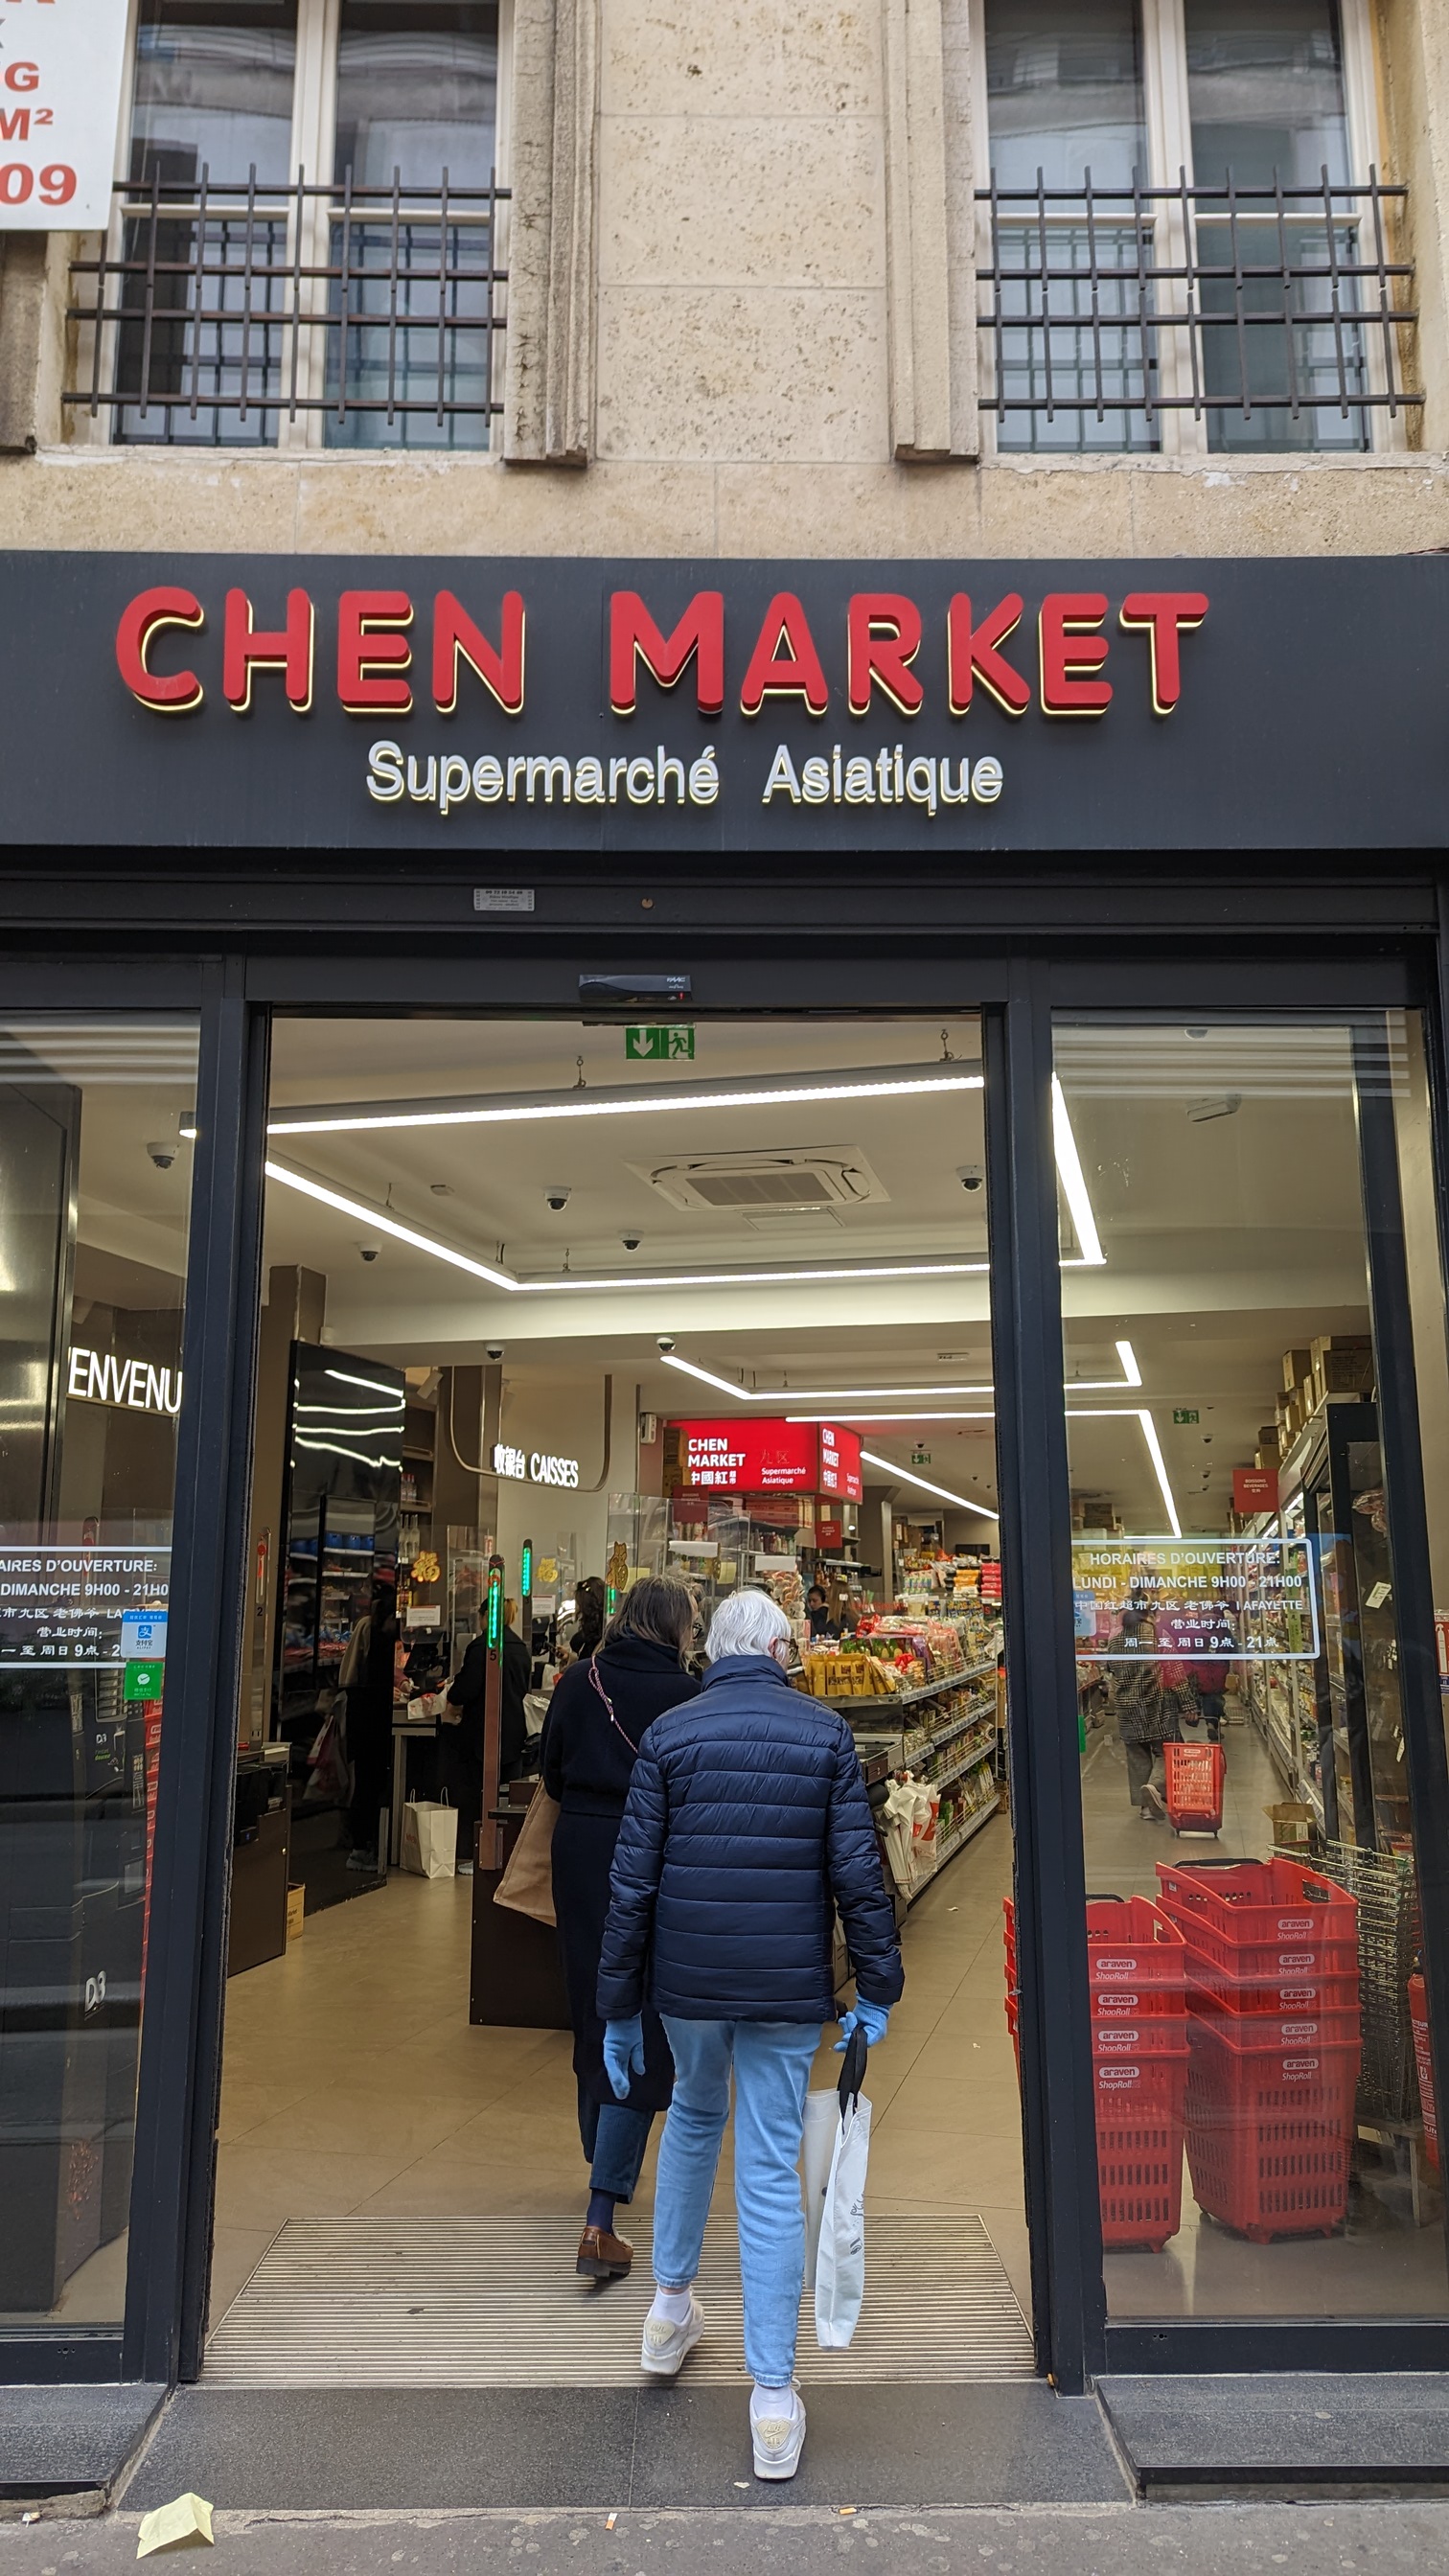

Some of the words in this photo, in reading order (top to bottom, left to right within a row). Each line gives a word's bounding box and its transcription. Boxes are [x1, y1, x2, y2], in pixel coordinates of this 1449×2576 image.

[116, 586, 525, 714] CHEN
[610, 590, 1209, 715] MARKET
[366, 741, 720, 815] Supermarché
[763, 745, 1003, 816] Asiatique
[688, 1438, 728, 1451] CHEN
[688, 1453, 746, 1467] MARKET
[530, 1452, 579, 1488] CAISSES
[761, 1466, 806, 1475] Supermarché
[762, 1477, 794, 1485] Asiatique
[1091, 1552, 1166, 1565] HORAIRES
[1072, 1576, 1116, 1589] LUNDI
[1129, 1576, 1208, 1589] DIMANCHE
[1210, 1576, 1246, 1588] 9H00
[1258, 1576, 1302, 1588] 21H00
[1, 1583, 80, 1597] DIMANCHE
[84, 1583, 121, 1597] 9H00
[257, 1606, 264, 1617] 2
[490, 1649, 496, 1661] 5
[1281, 1920, 1310, 1928] araven
[1282, 1955, 1311, 1964] araven
[1102, 1995, 1134, 2004] araven
[1283, 1990, 1312, 1998] araven
[1285, 2024, 1314, 2033] araven
[1286, 2059, 1315, 2068] araven
[1103, 2068, 1136, 2077] araven
